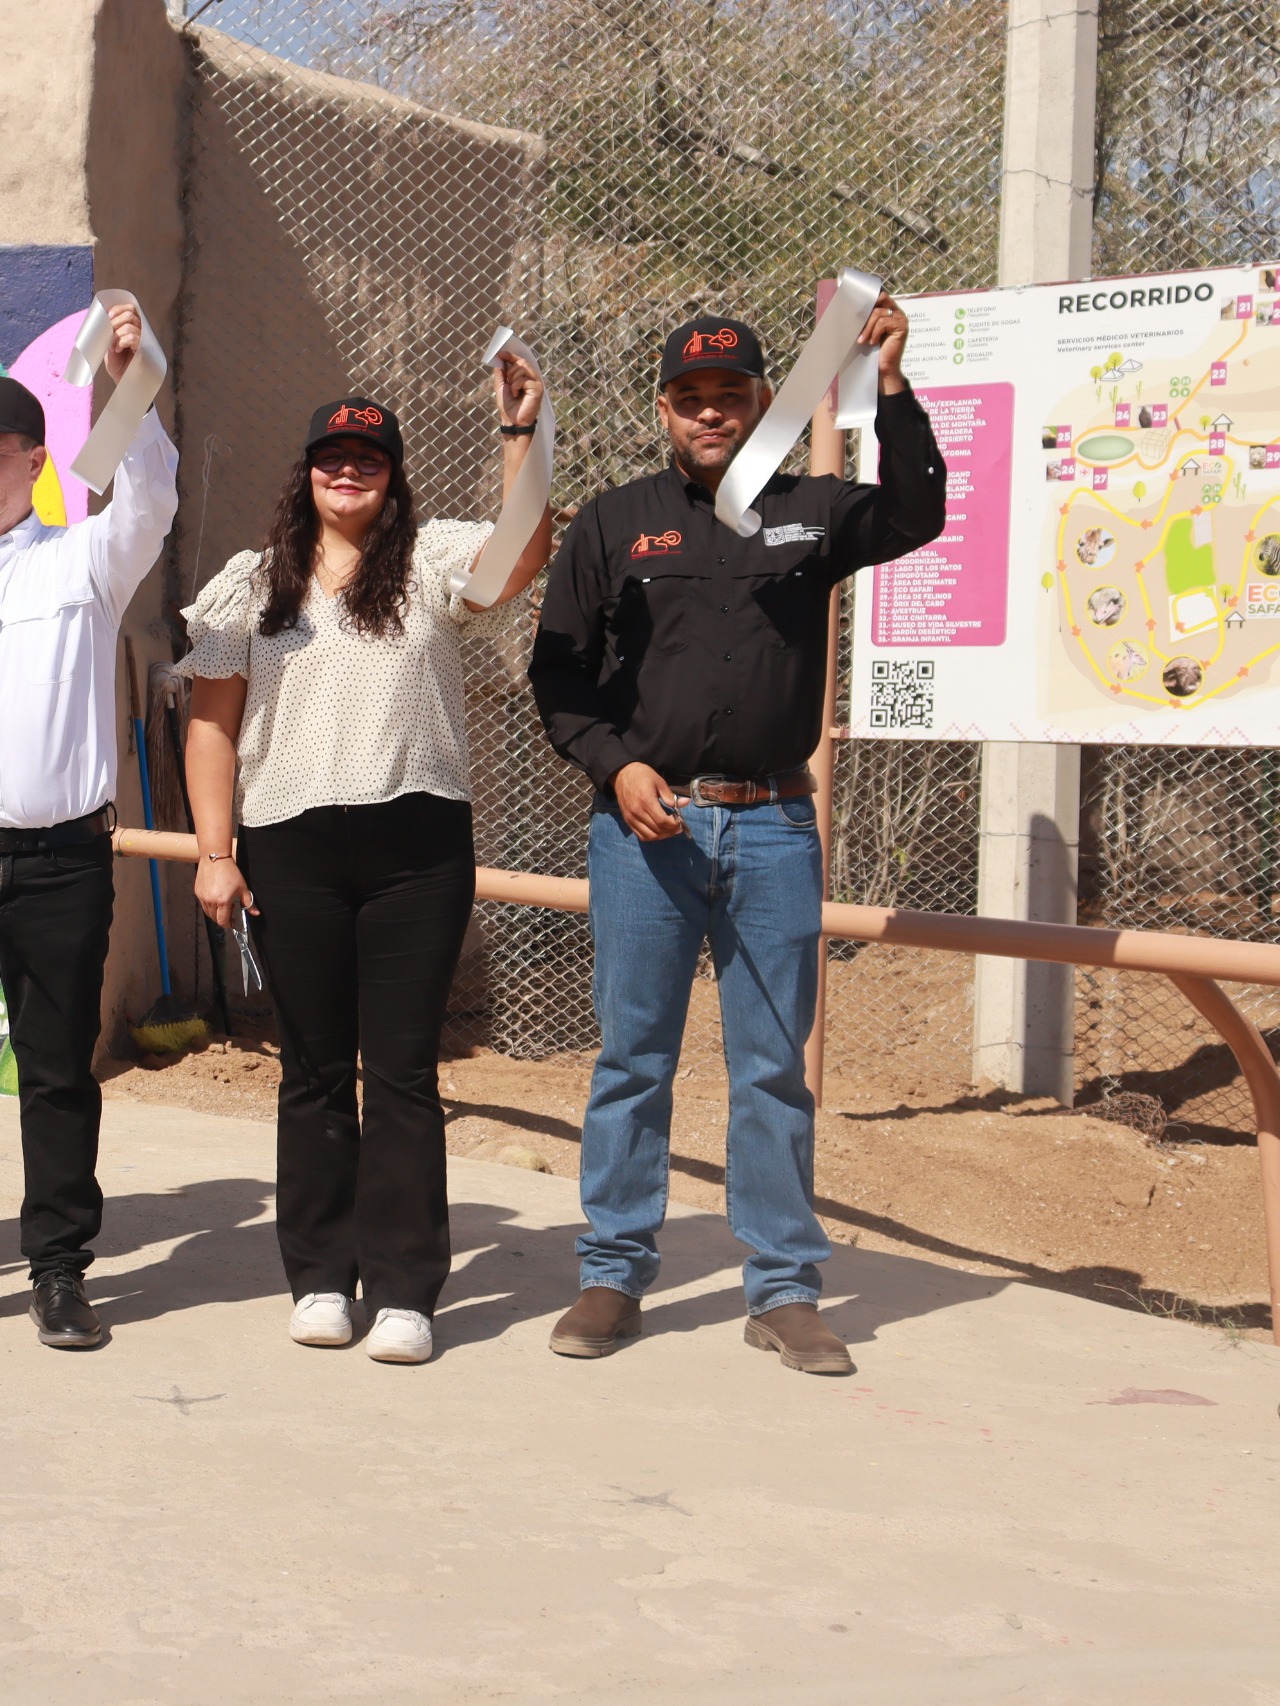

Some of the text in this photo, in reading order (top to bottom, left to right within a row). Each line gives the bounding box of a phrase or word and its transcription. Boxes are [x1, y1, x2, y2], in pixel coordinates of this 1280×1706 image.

[1058, 283, 1214, 314] RECORRIDO
[1239, 302, 1250, 312] 21
[1057, 336, 1095, 344] SERVICIOS
[1130, 329, 1184, 338] VETERINARIOS
[1057, 344, 1092, 353] Veterinary
[1212, 369, 1226, 379] 22
[1117, 411, 1130, 420] 24
[1153, 410, 1166, 420] 23
[952, 418, 986, 428] MONTAÑA
[1058, 432, 1070, 442] 25
[1210, 439, 1224, 449] 28
[1267, 452, 1280, 462] 29
[1062, 465, 1074, 474] 26
[1094, 474, 1107, 484] 27
[1248, 584, 1280, 602] EC
